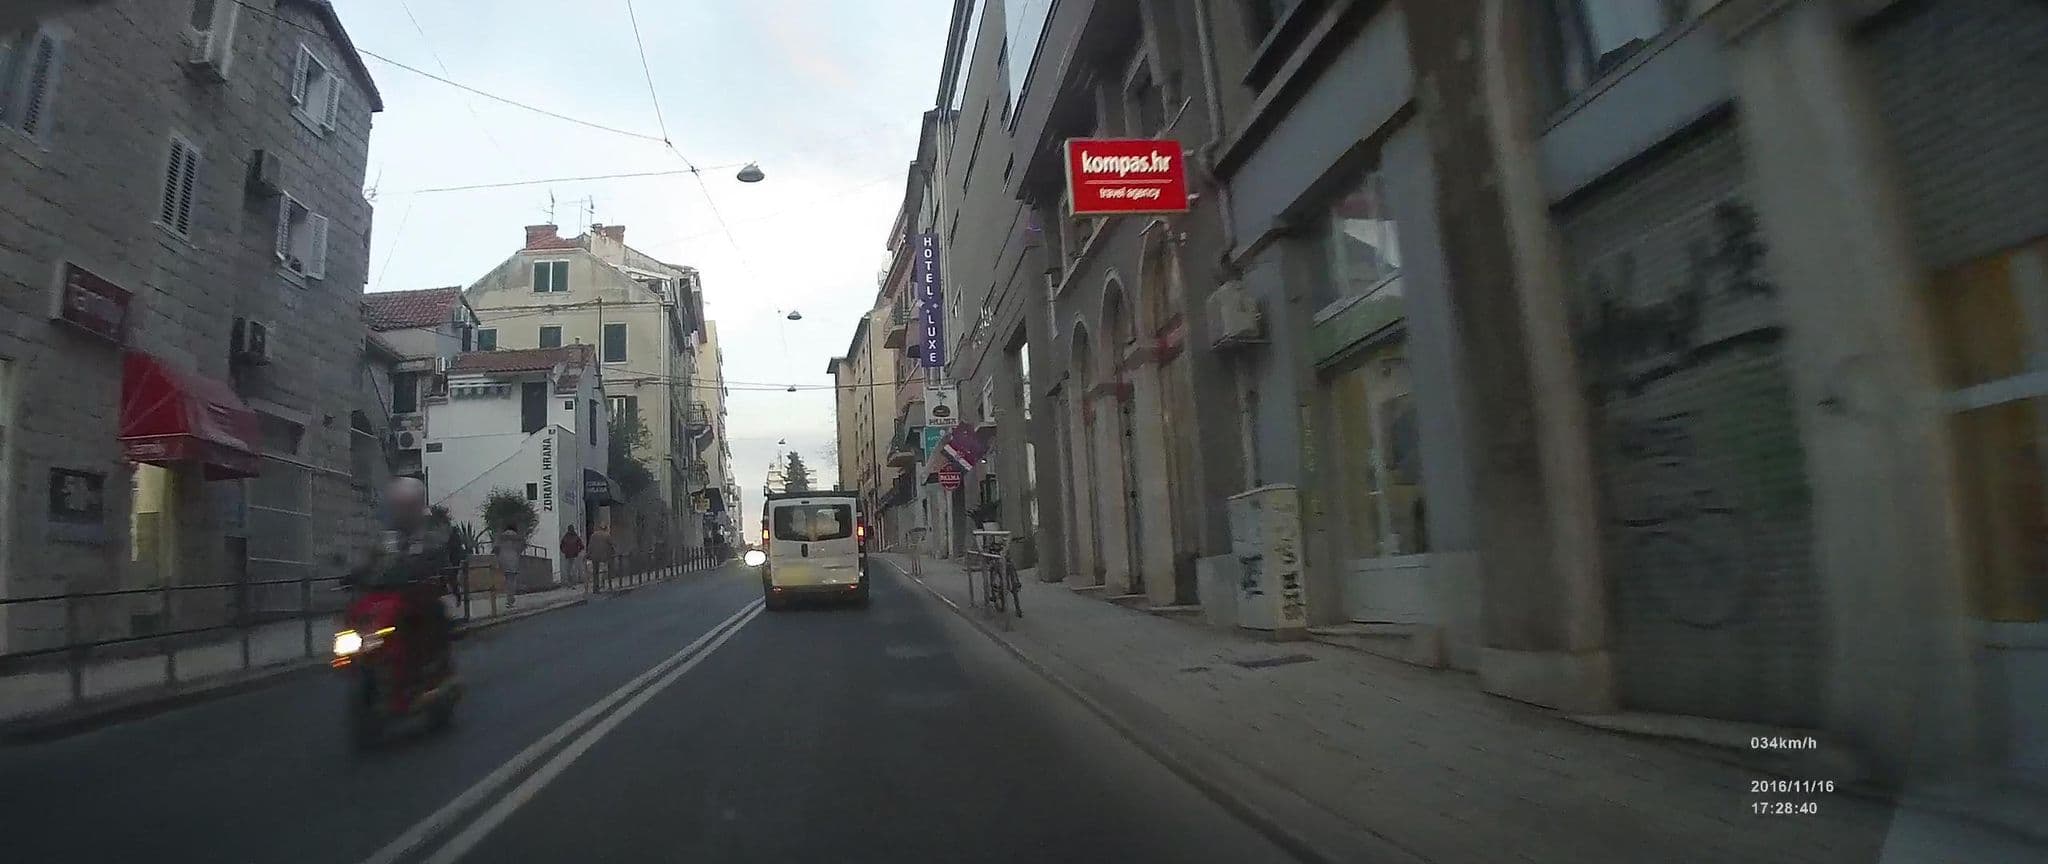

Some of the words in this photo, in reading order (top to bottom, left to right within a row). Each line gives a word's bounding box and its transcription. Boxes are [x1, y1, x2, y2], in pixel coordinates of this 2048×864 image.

[1082, 150, 1172, 178] kompas.hr
[1099, 187, 1126, 199] travel
[1127, 188, 1161, 200] agency
[923, 237, 934, 296] HOTEL
[927, 314, 937, 362] LUXE
[542, 438, 552, 470] HRANA
[543, 474, 553, 511] ZDRAVA
